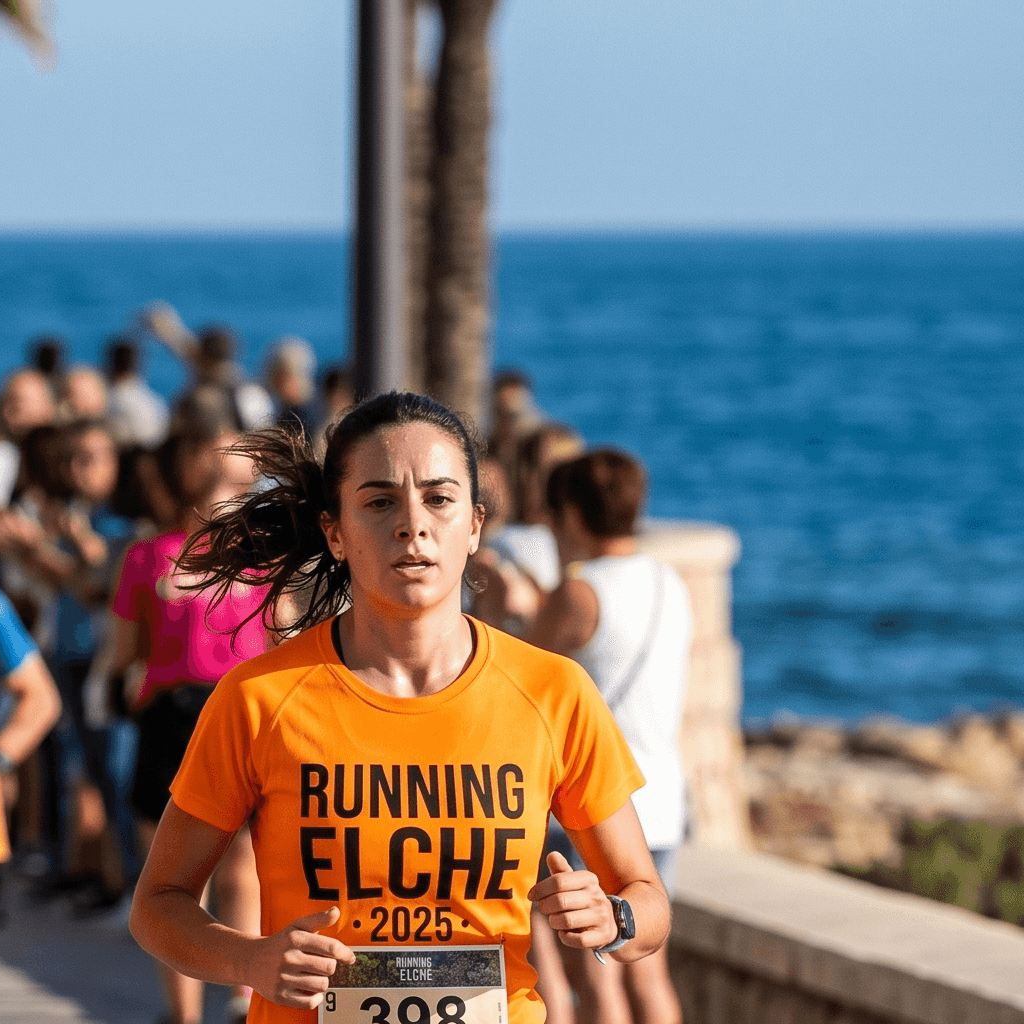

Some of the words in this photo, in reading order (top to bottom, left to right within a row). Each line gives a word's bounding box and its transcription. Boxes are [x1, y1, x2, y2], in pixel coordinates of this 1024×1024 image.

[300, 763, 525, 820] RUNNING
[300, 826, 526, 902] ELCHE
[370, 906, 453, 942] 2025
